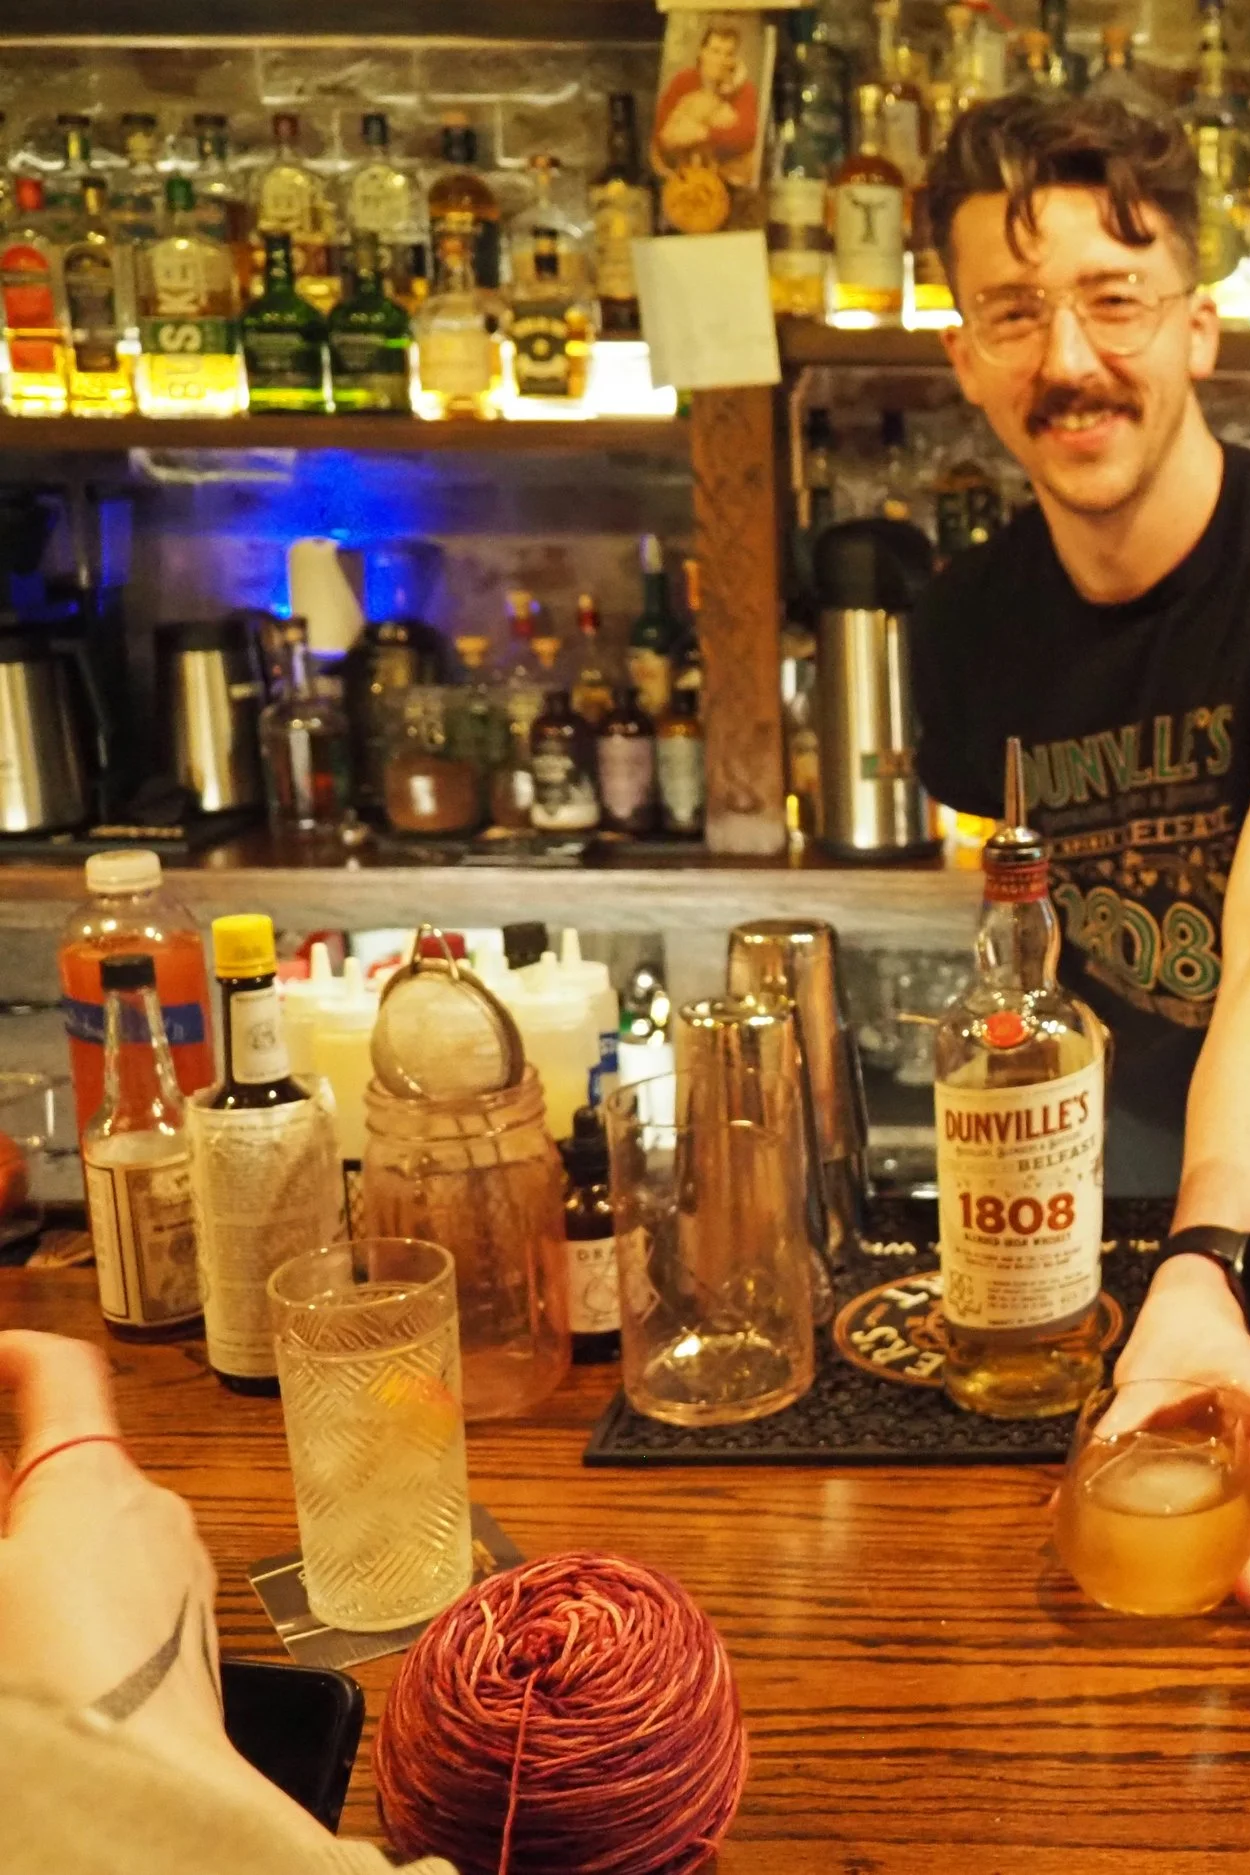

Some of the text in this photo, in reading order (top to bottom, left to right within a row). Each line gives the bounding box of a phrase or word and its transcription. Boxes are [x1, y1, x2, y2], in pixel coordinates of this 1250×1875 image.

[945, 1090, 1089, 1144] DUNVILLE'S
[1017, 1135, 1096, 1172] BELFAST
[958, 1192, 1075, 1236] 1808
